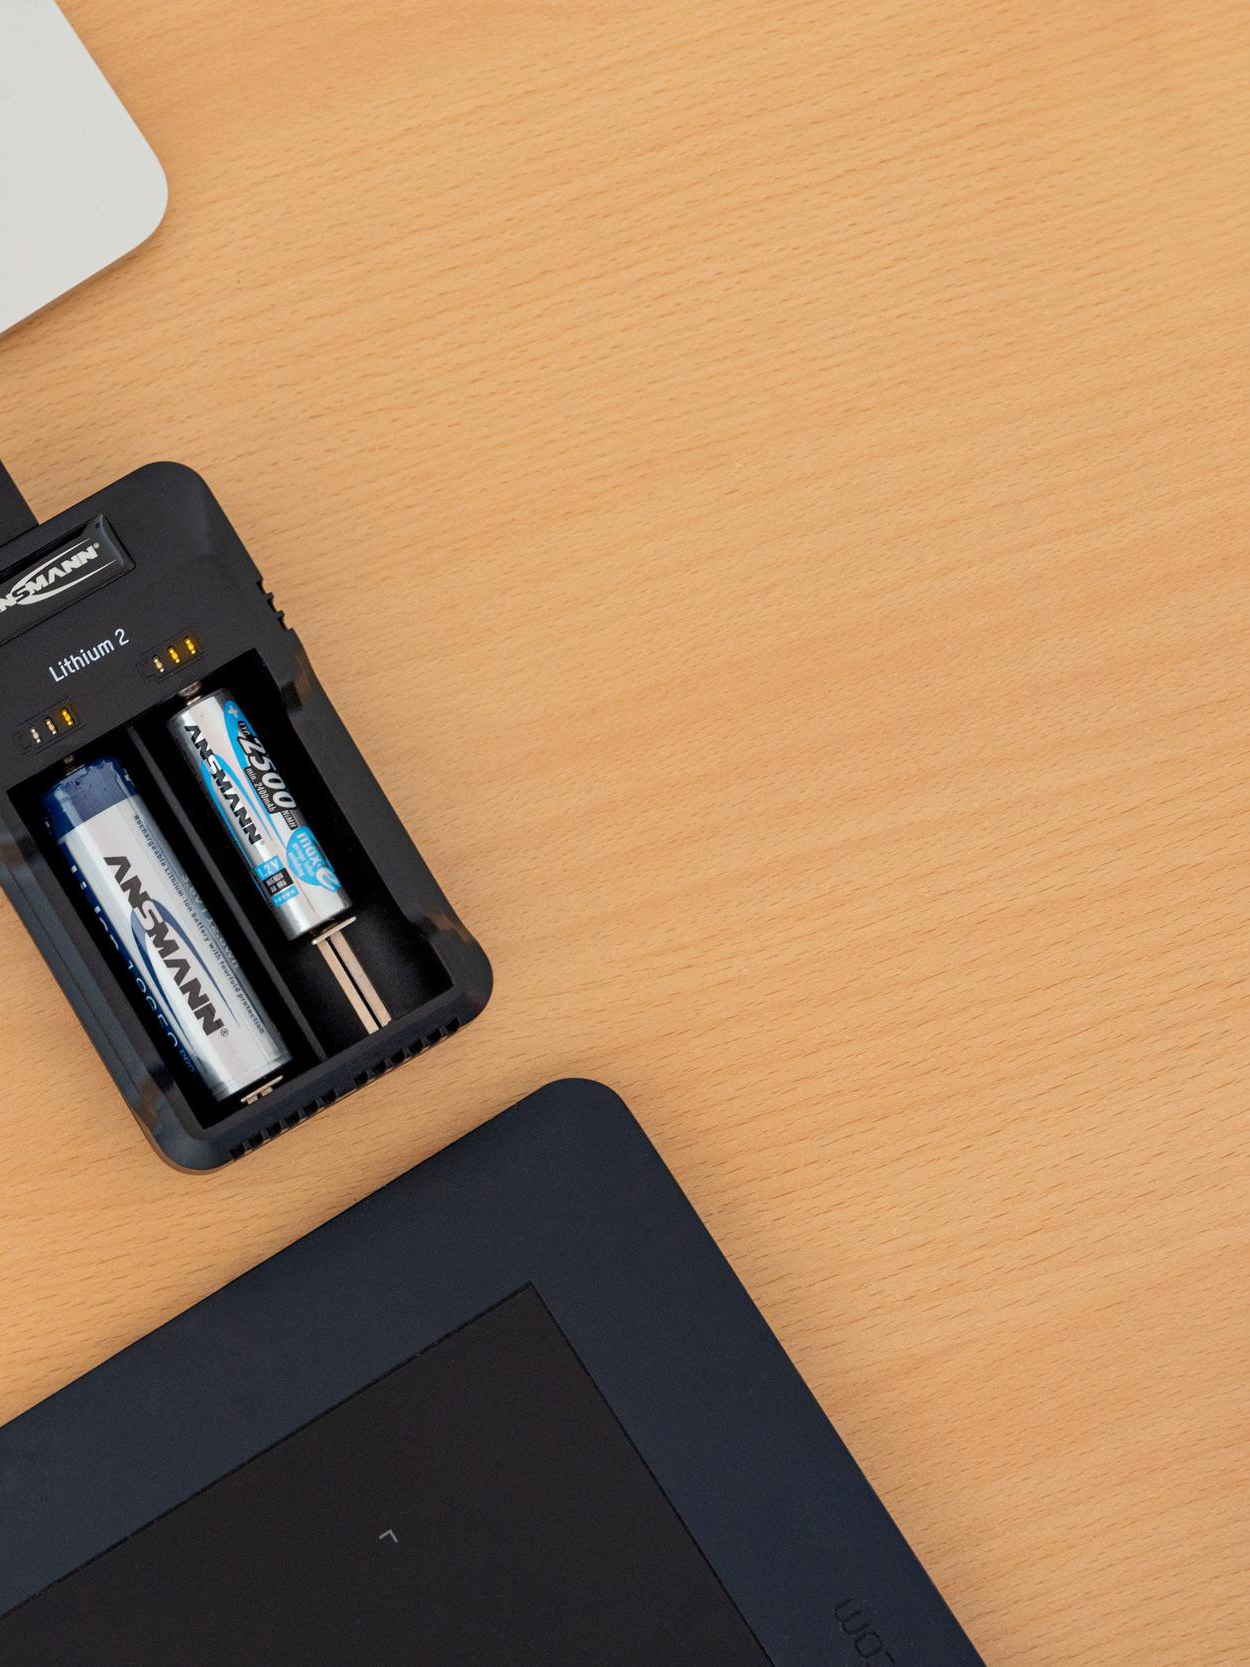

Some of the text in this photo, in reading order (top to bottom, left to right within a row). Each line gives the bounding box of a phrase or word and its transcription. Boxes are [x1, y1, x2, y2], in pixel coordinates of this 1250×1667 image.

[48, 628, 130, 682] Lithium 2
[238, 736, 297, 809] 2500
[254, 783, 277, 813] 2400mAh
[134, 815, 166, 868] Rechargeable
[191, 912, 209, 942] battery
[209, 942, 221, 961] with
[220, 960, 240, 994] fourfold
[238, 993, 265, 1035] protection
